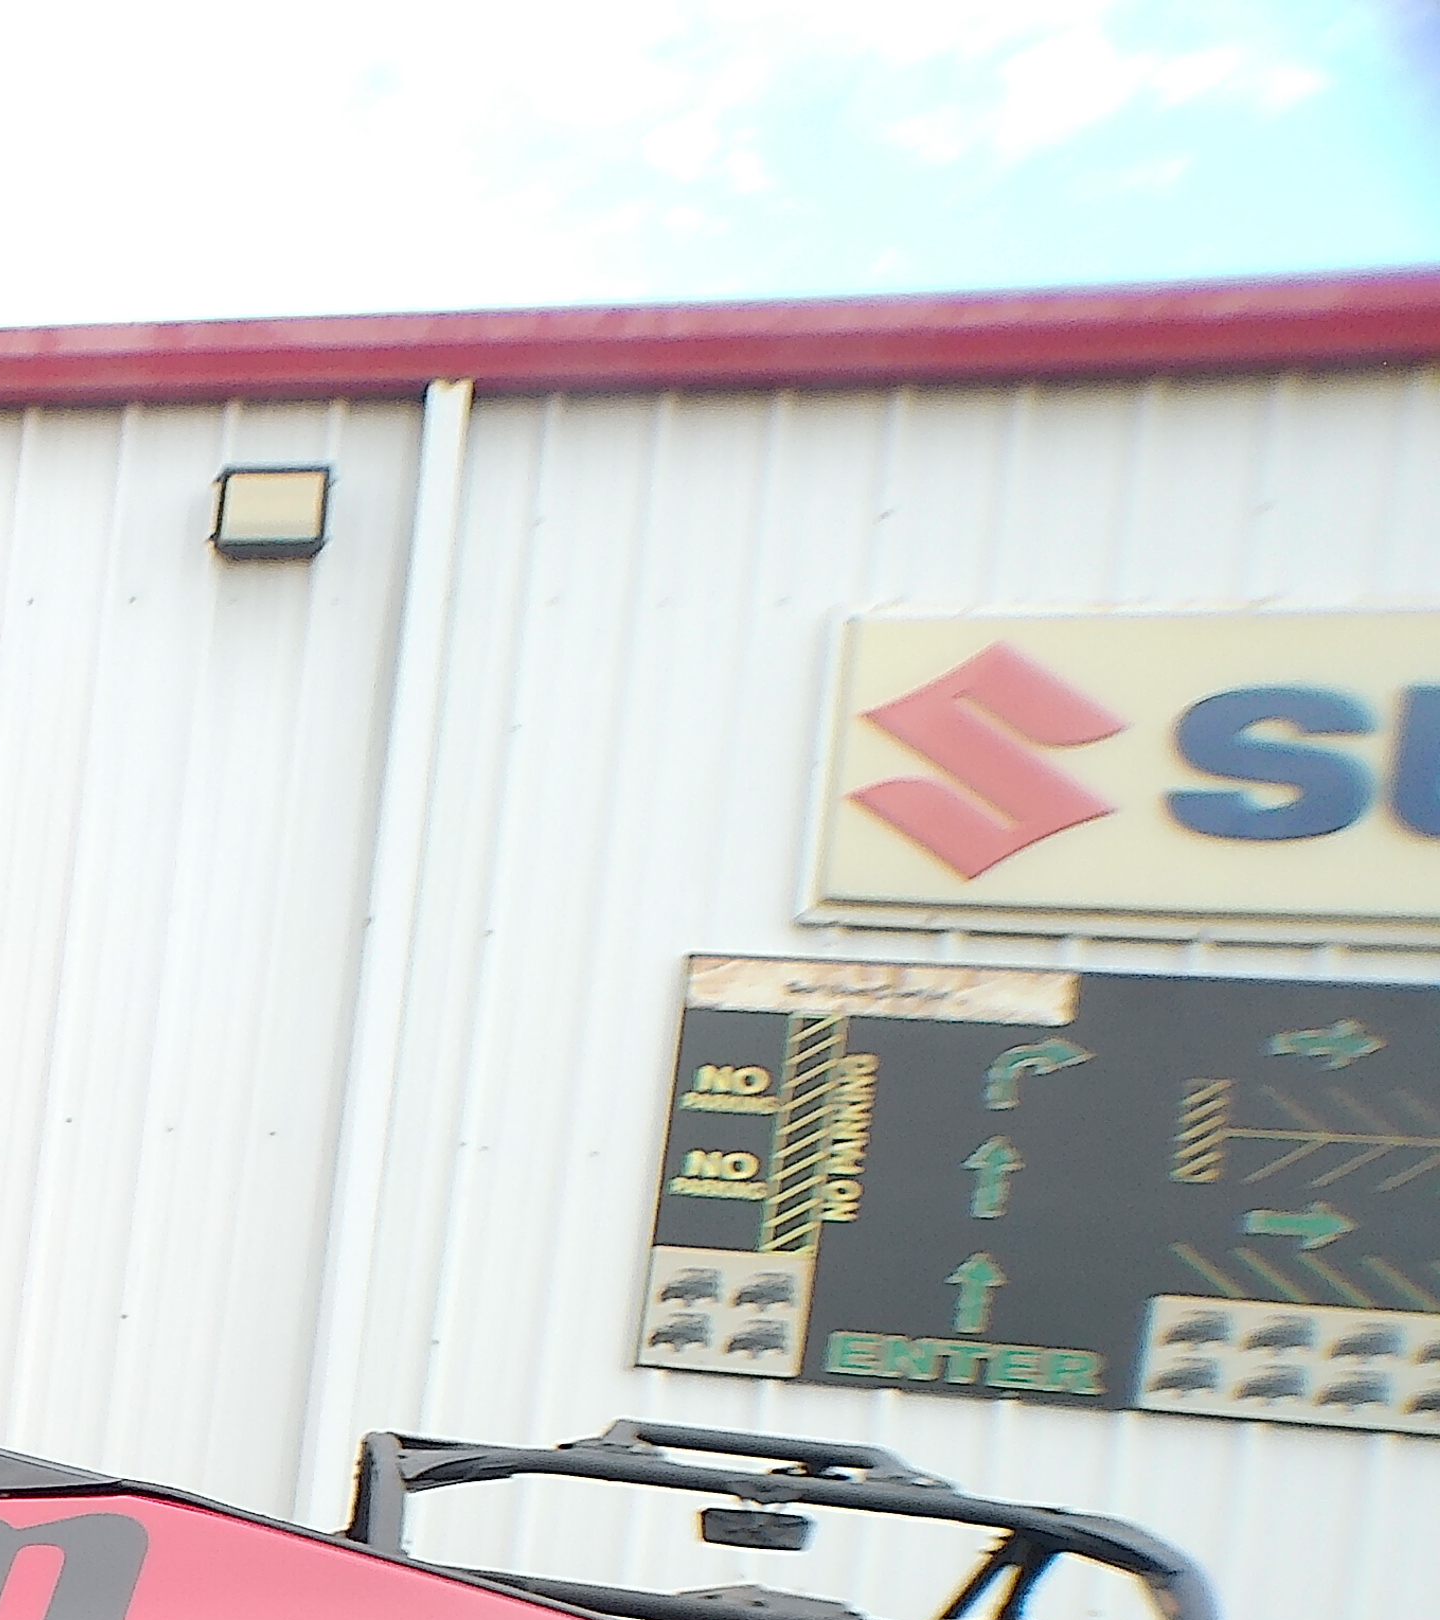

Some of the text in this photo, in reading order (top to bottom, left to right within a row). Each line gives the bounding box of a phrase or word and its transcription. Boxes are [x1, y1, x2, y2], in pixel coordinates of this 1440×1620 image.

[1164, 685, 1440, 842] S
[693, 1064, 772, 1095] NO
[681, 1149, 761, 1181] NO
[819, 1178, 865, 1223] NO
[824, 1330, 1107, 1396] ENTER
